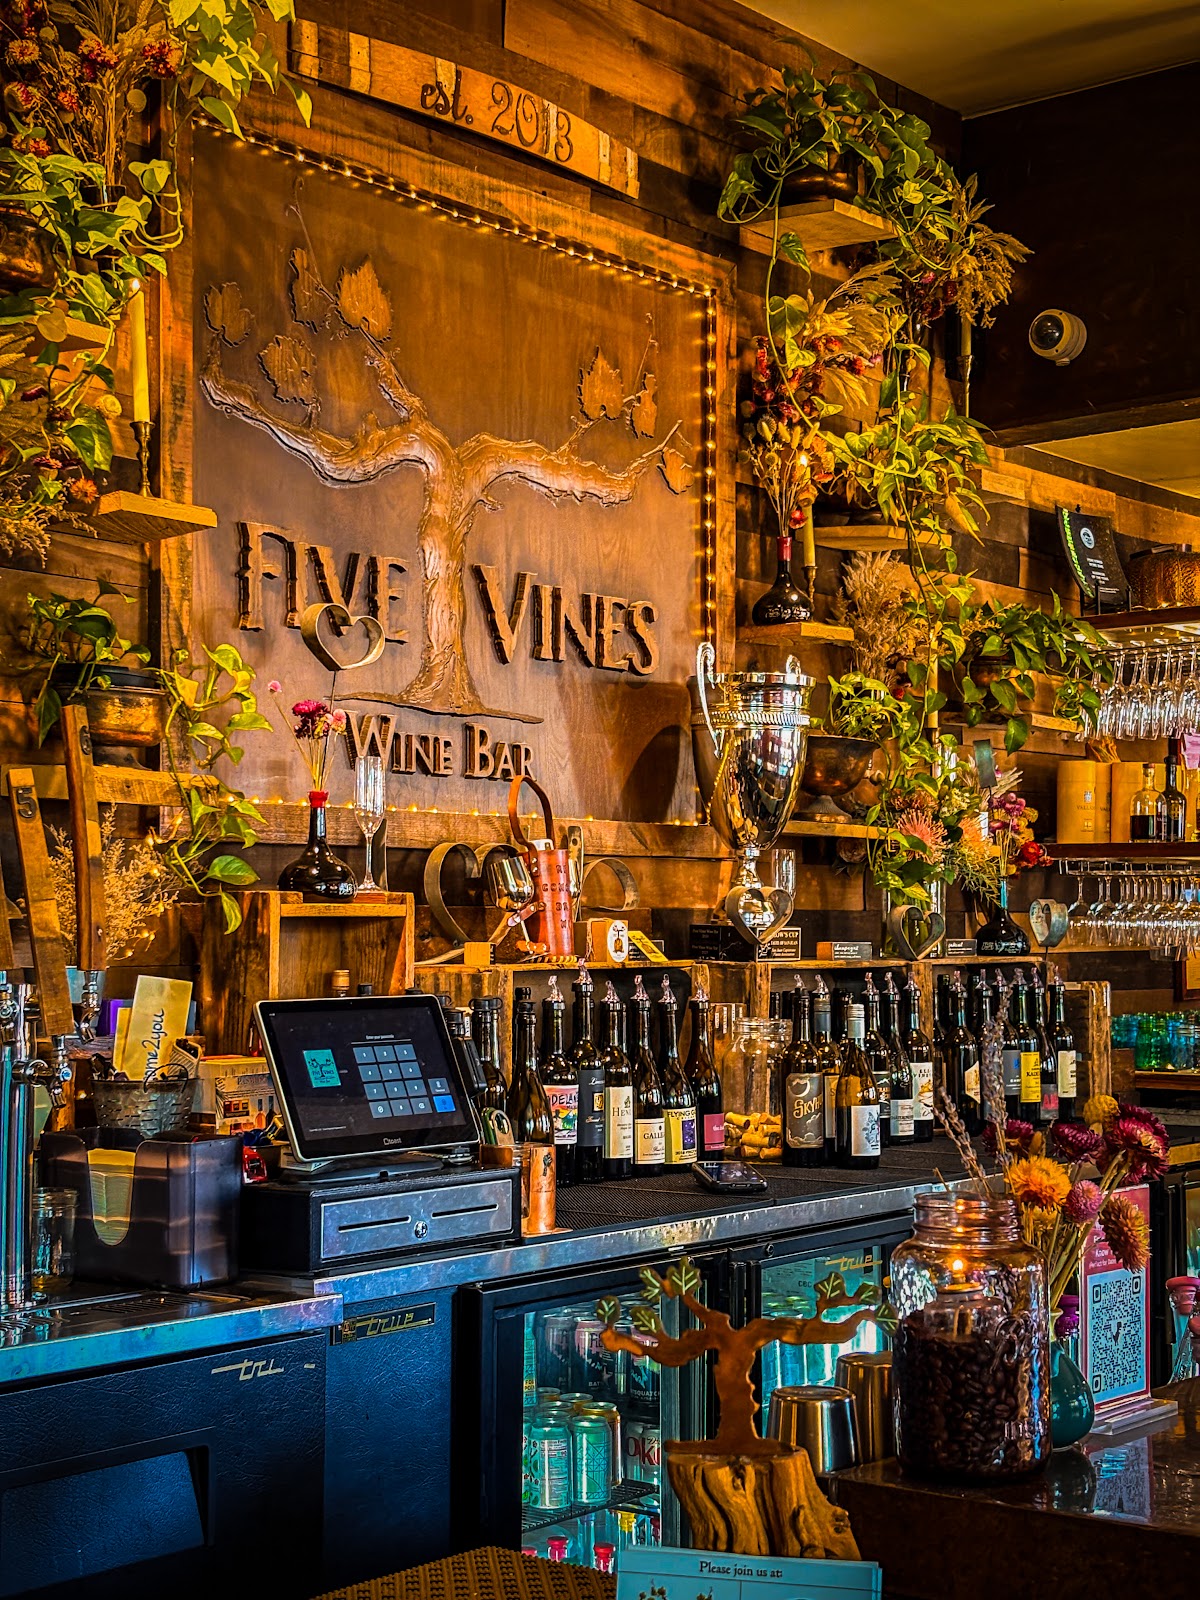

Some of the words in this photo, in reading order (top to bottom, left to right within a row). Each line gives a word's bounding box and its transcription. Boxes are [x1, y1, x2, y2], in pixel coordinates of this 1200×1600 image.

[420, 69, 474, 125] est.
[491, 81, 573, 162] 2013
[235, 520, 410, 645] FIVE
[471, 563, 660, 677] VINES
[16, 786, 37, 819] 5
[825, 1255, 883, 1272] true
[699, 1560, 731, 1574] Please
[733, 1563, 753, 1578] join
[756, 1568, 768, 1578] us
[769, 1568, 783, 1578] at:
